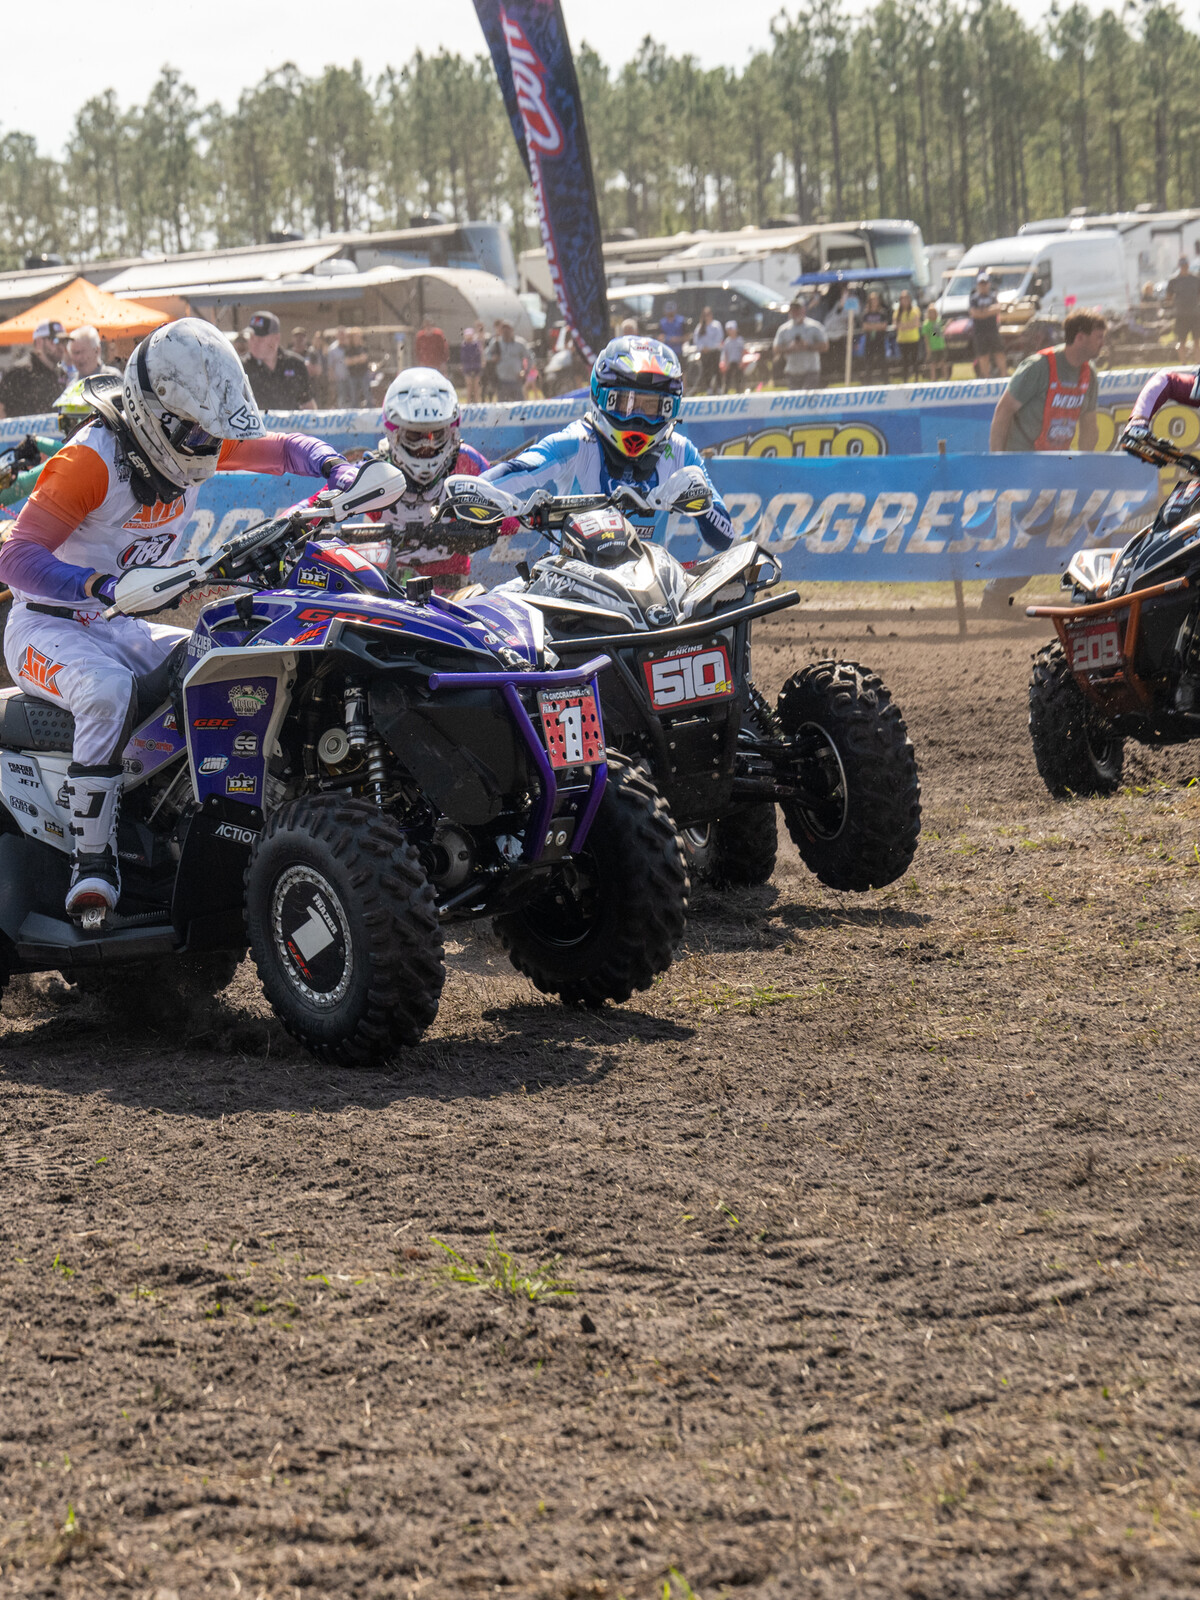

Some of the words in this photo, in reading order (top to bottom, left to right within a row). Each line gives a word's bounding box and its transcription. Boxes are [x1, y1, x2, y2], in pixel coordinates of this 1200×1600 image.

[677, 398, 750, 417] RESSIVE
[770, 390, 891, 411] PROGRESSIVE
[335, 548, 369, 569] 1
[664, 644, 703, 658] JENKINS
[1073, 632, 1120, 671] 209
[652, 650, 726, 706] 510
[193, 719, 238, 727] GBC
[558, 706, 584, 763] 1
[8, 762, 33, 773] FRAZIER
[18, 777, 41, 789] JETT
[229, 780, 254, 788] DP
[312, 892, 338, 935] FRAZIER
